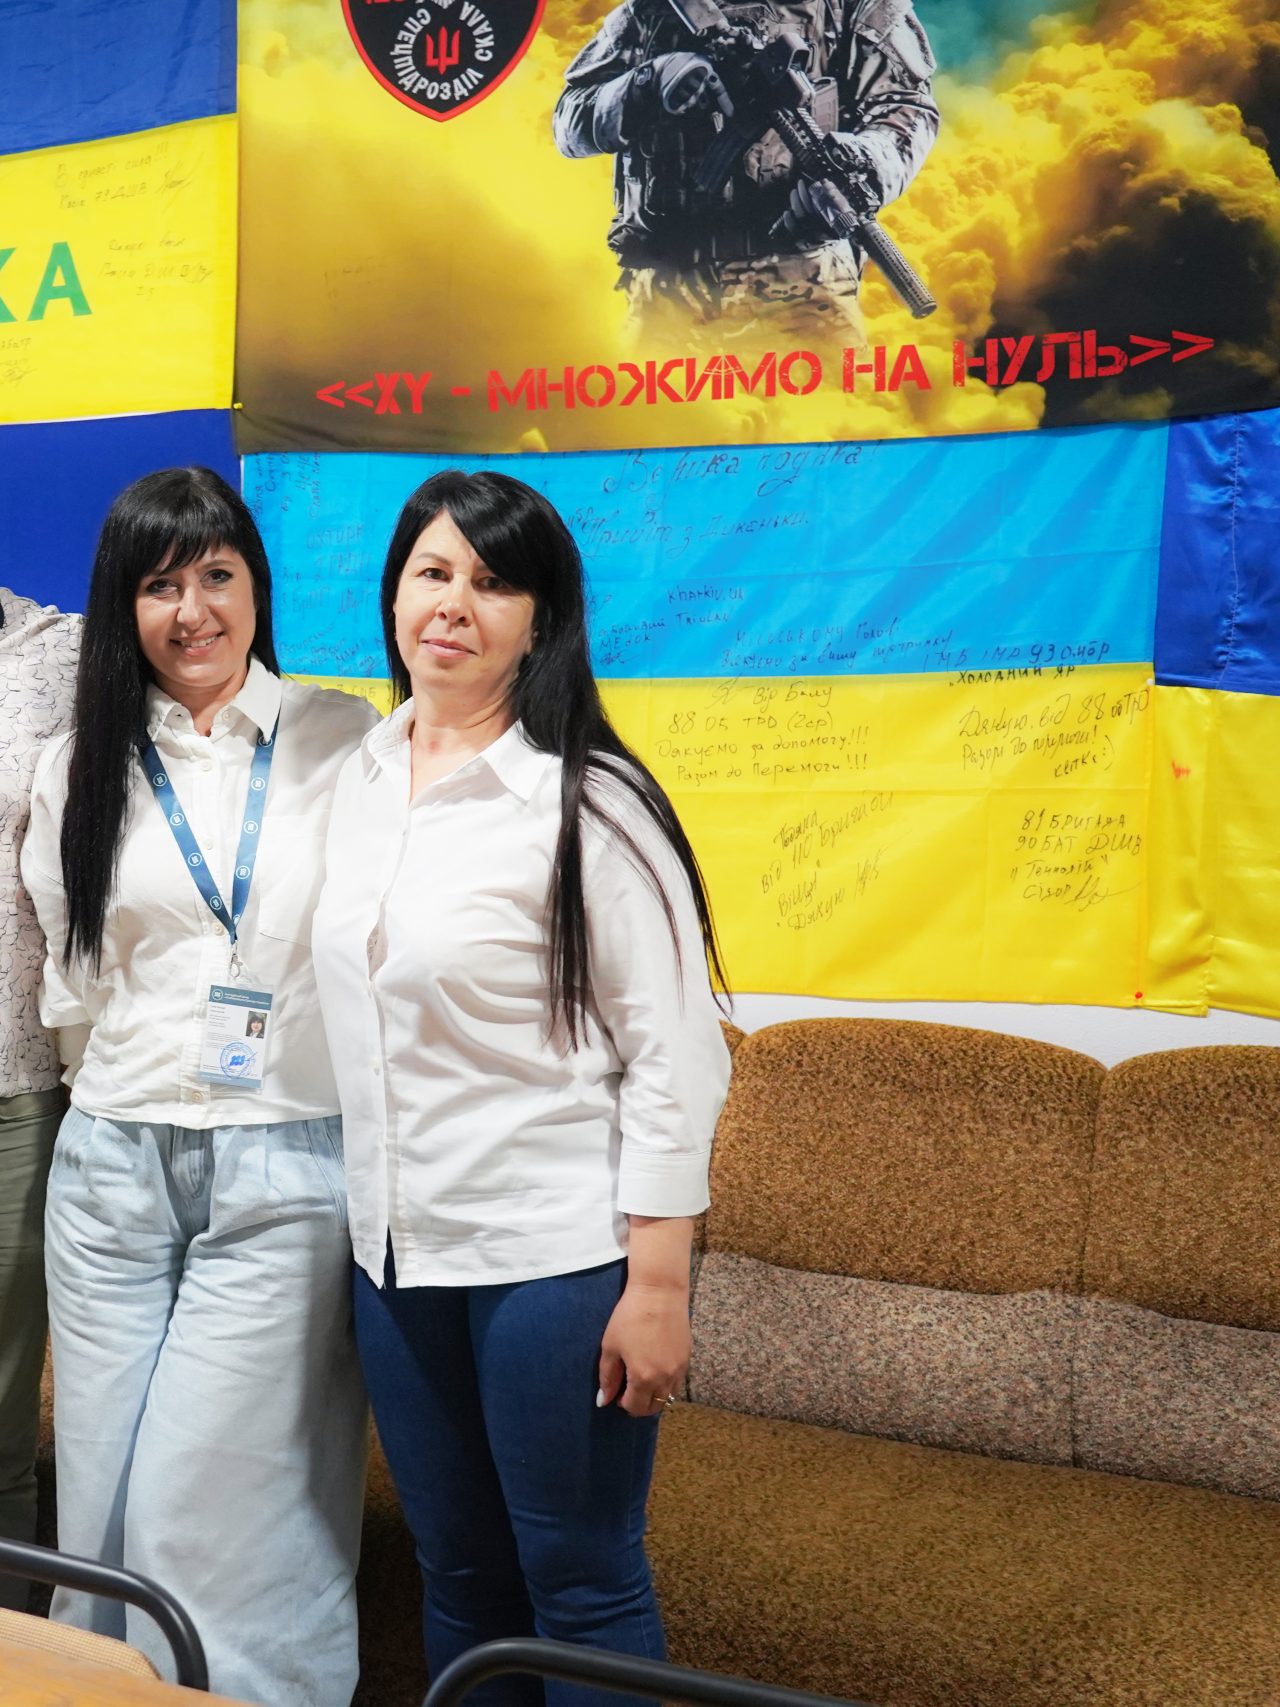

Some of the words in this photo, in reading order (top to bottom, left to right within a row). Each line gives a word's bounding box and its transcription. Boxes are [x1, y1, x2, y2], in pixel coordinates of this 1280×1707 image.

[389, 8, 484, 101] СПЕЦПІДРОЗДІЛ
[458, 1, 496, 62] СКАЛА
[488, 350, 823, 414] МНОЖИМО
[841, 344, 932, 394] НА
[725, 765, 743, 779] до
